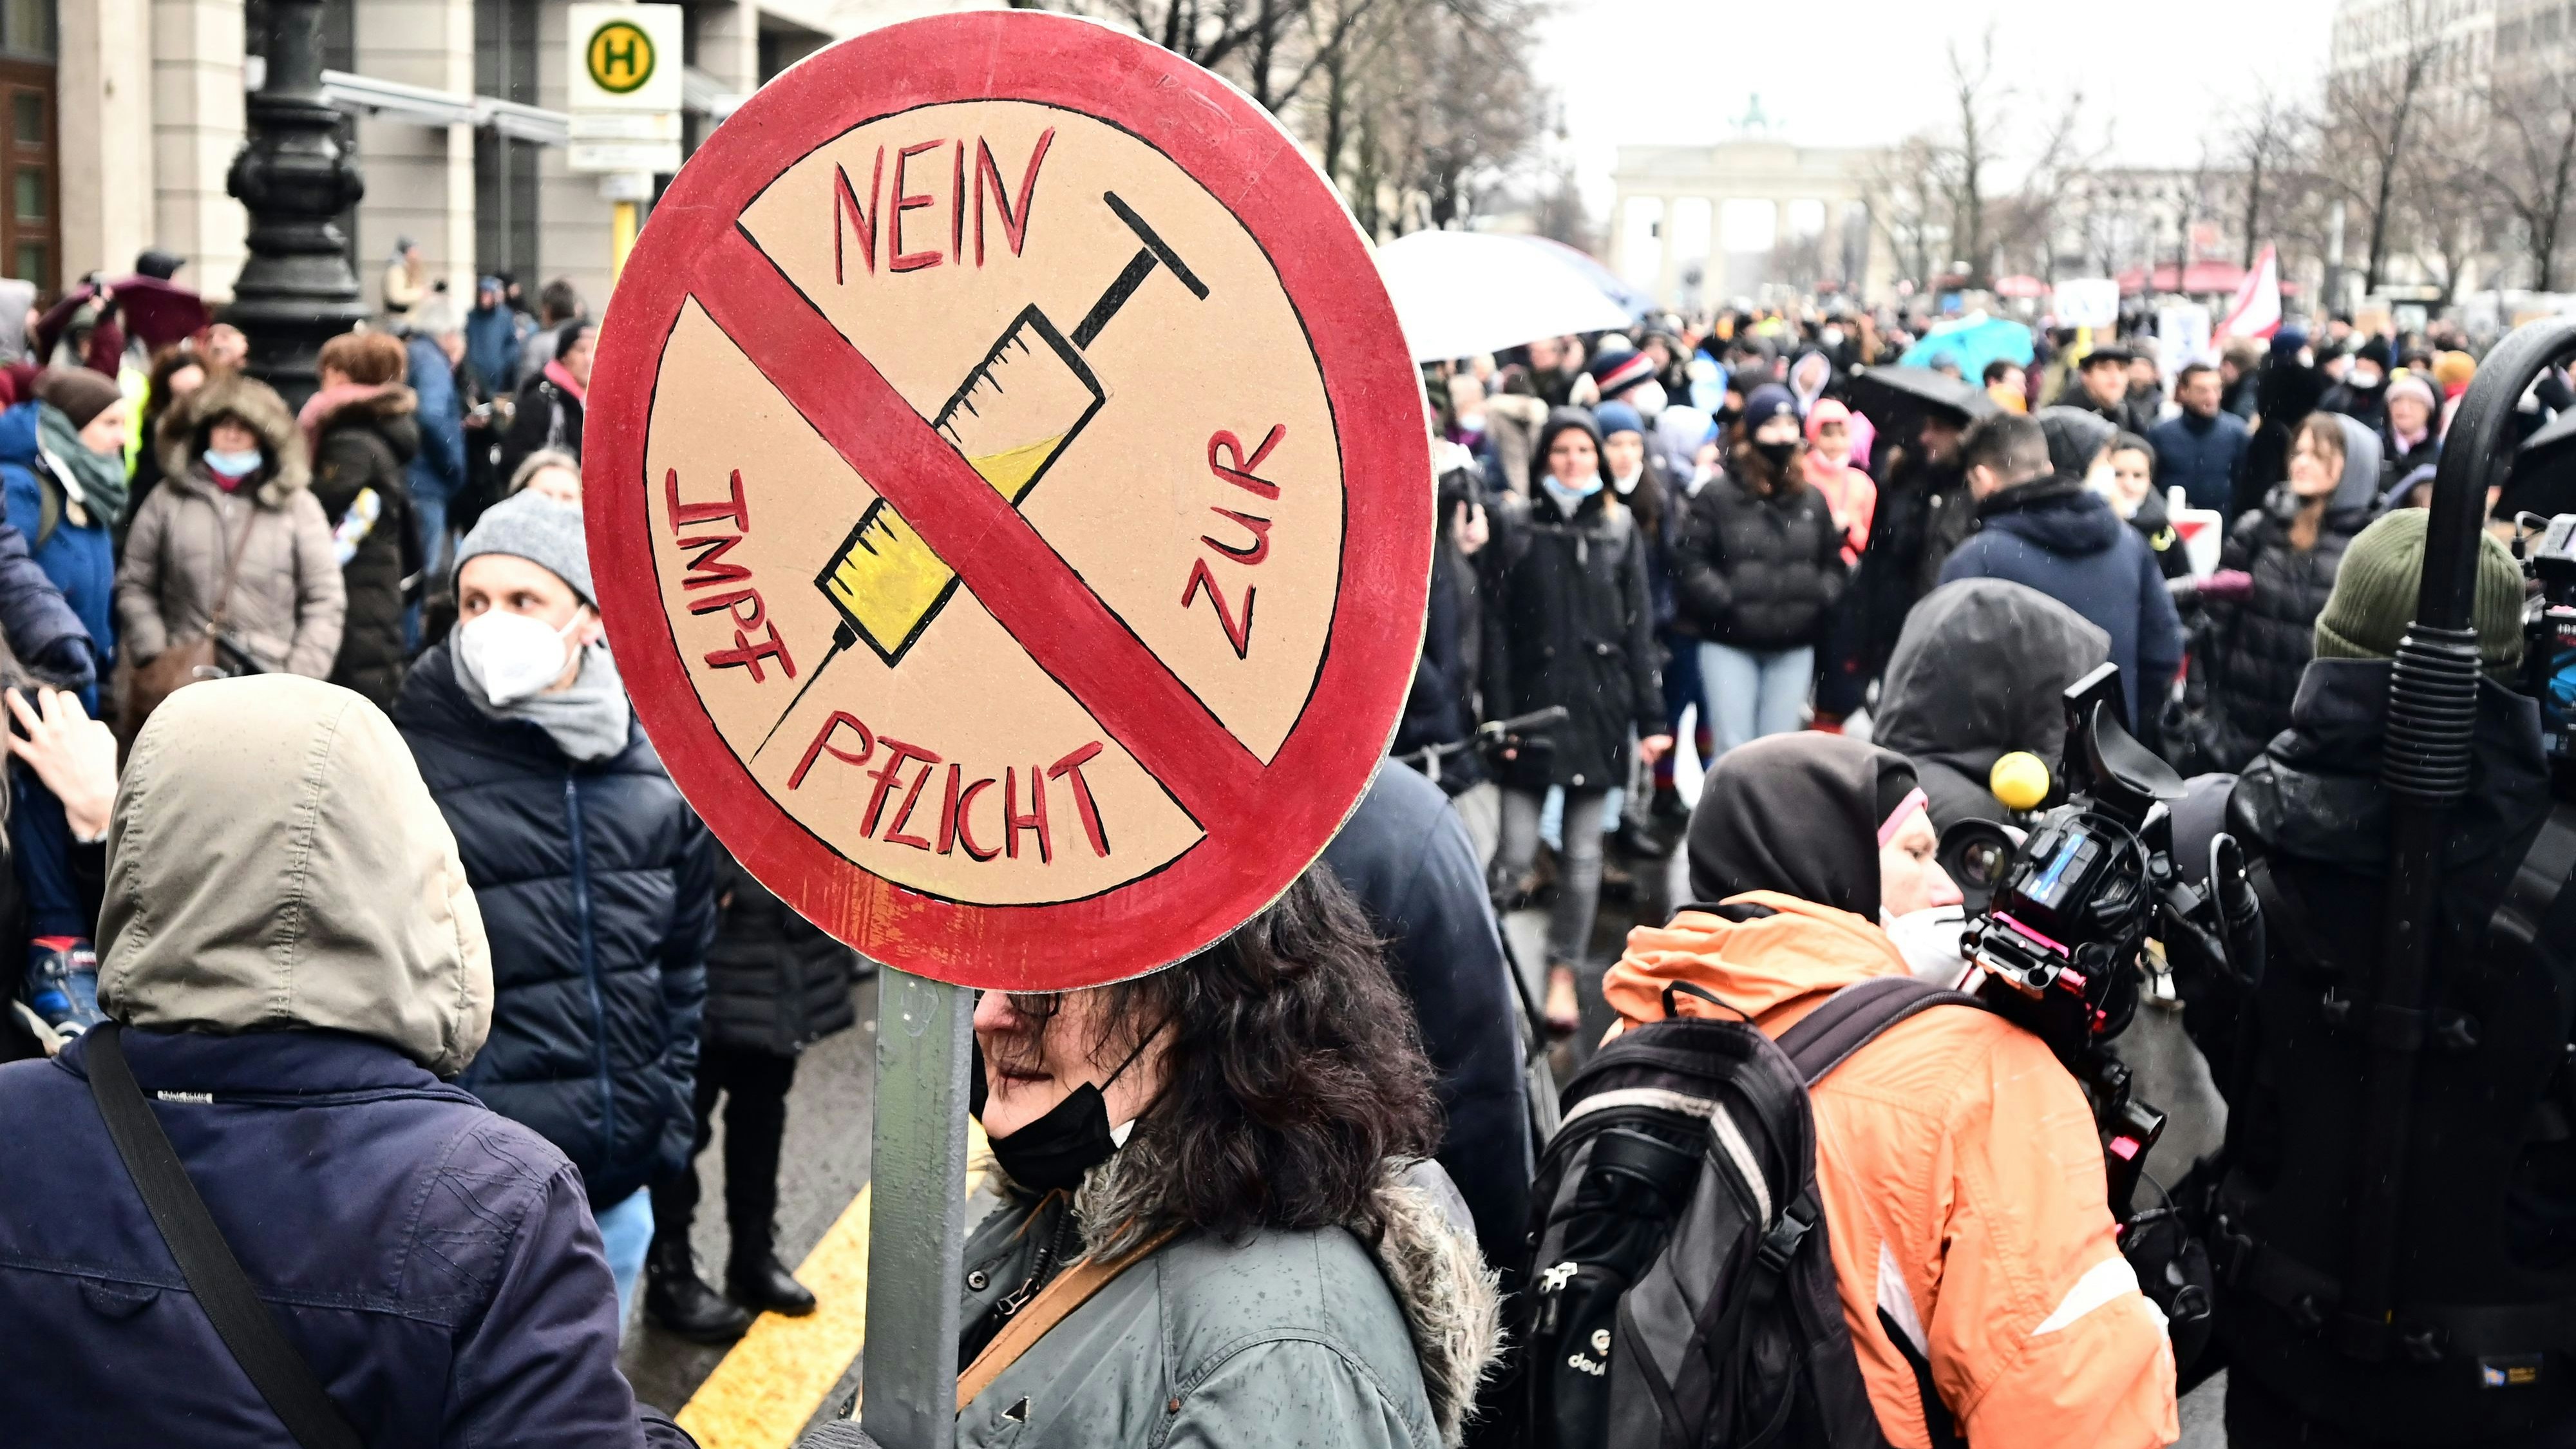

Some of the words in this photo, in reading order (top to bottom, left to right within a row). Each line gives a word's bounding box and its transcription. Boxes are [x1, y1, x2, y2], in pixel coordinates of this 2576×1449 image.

[605, 39, 636, 76] H
[834, 126, 1055, 285] NEIN
[665, 468, 797, 684] IMPF
[1181, 423, 1286, 660] ZUR
[787, 710, 1110, 866] PFLICHT
